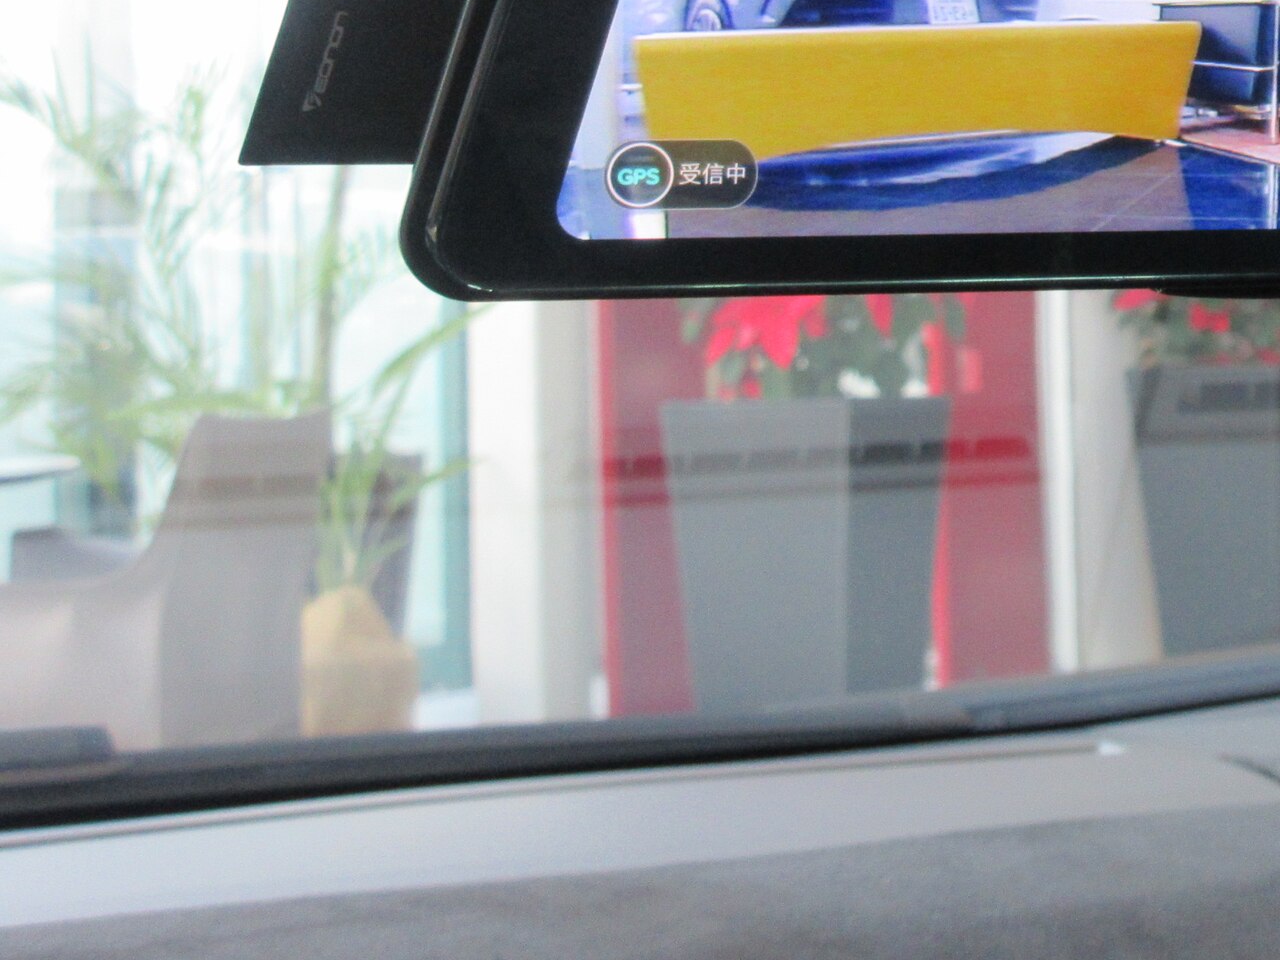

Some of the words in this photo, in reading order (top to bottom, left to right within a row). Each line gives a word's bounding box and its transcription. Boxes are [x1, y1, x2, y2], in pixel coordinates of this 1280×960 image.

[617, 166, 660, 186] GPS
[678, 162, 746, 185] 受信中
